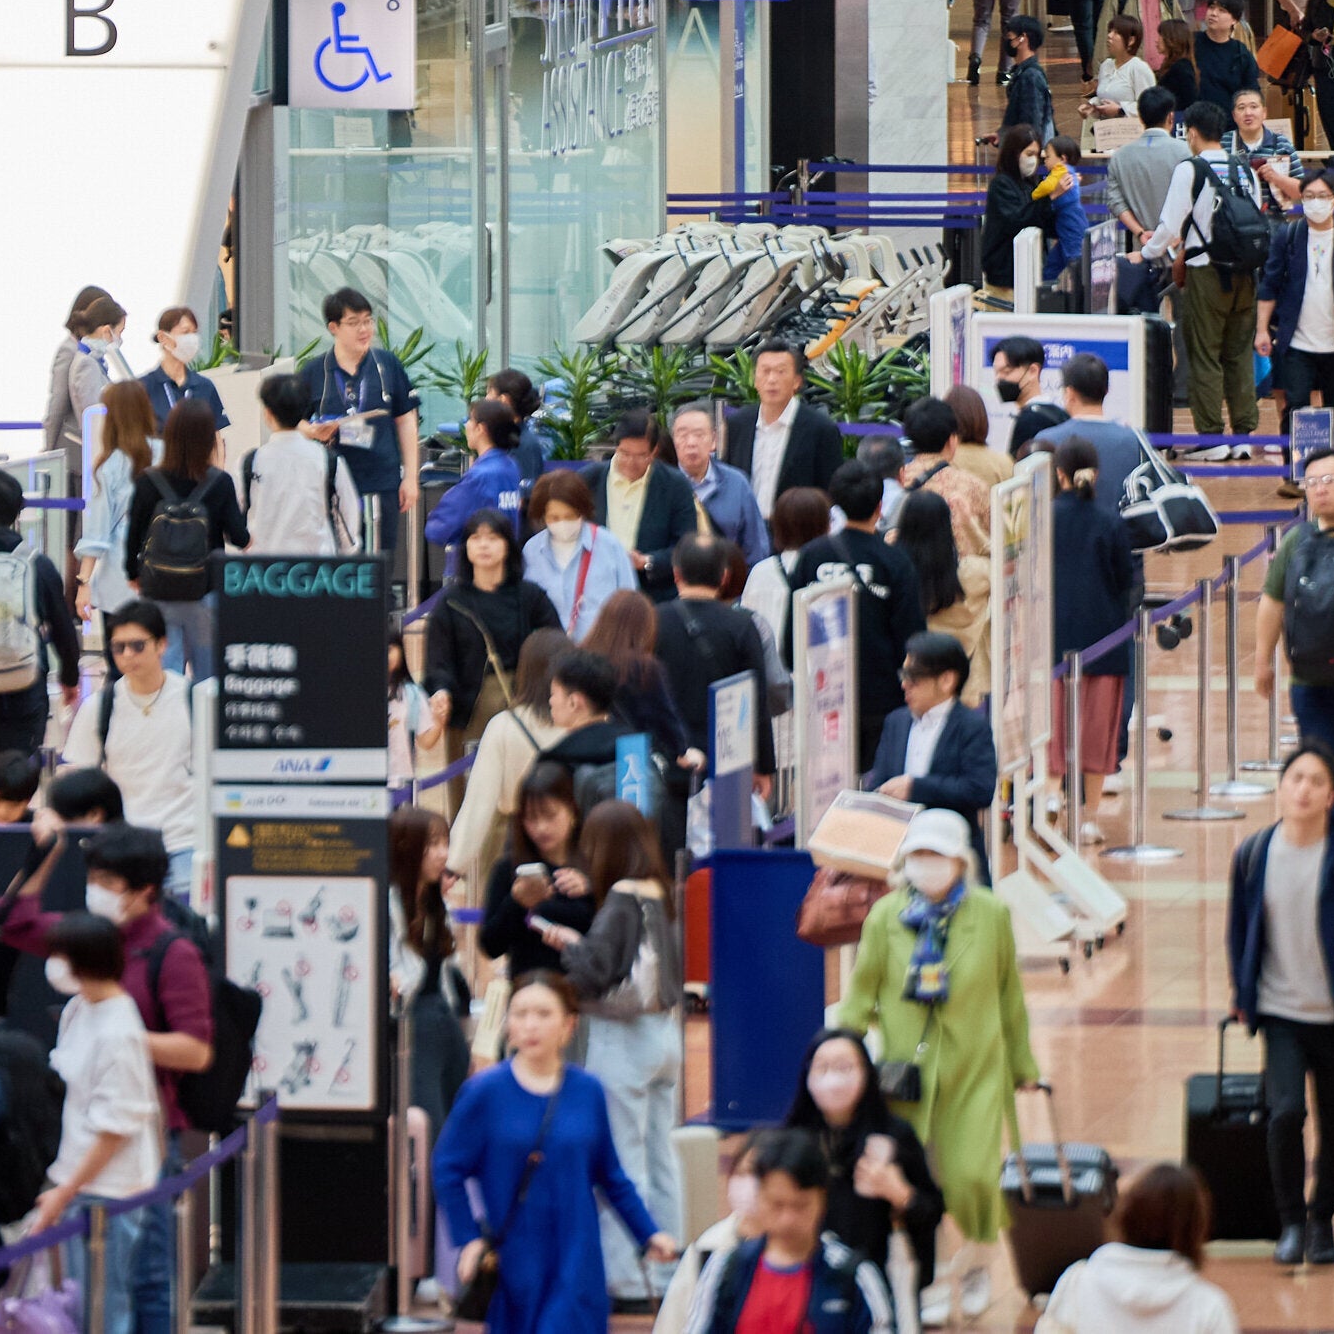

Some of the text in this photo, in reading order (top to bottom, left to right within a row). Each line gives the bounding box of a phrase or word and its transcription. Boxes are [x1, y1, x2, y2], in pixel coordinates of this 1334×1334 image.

[224, 562, 375, 598] BAGGAGE
[224, 674, 301, 699] Baggage
[272, 758, 312, 773] ANA
